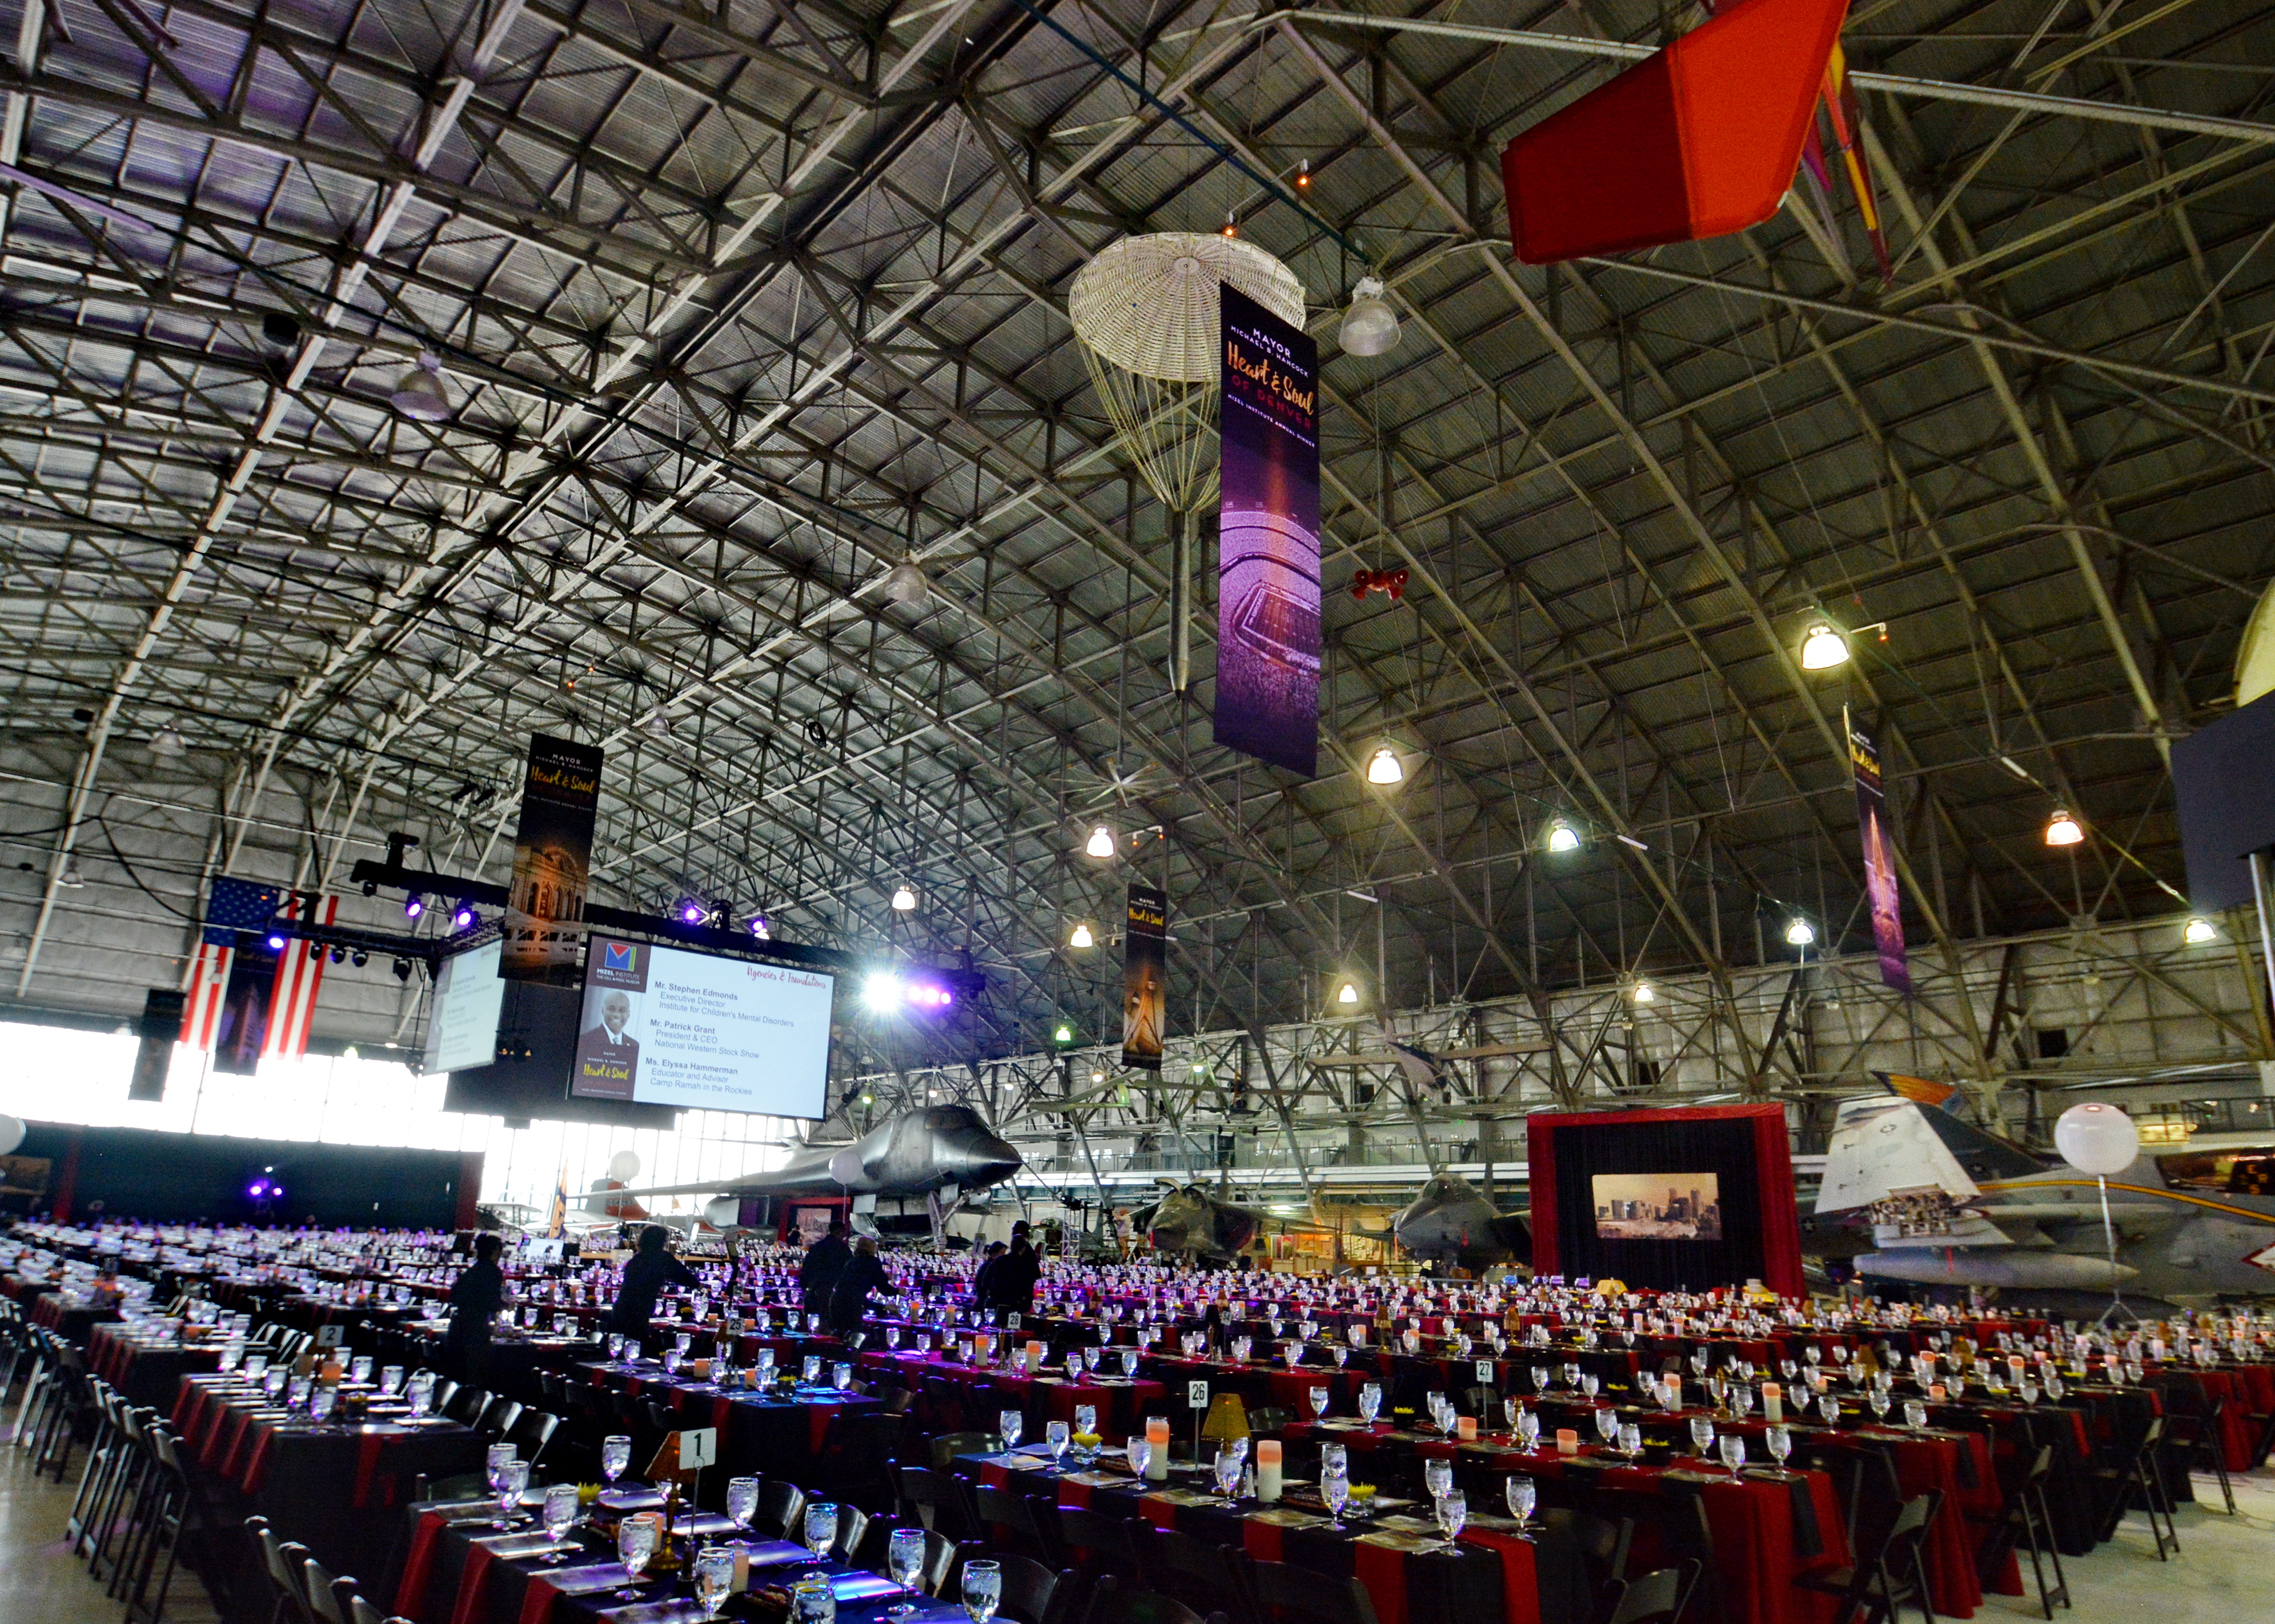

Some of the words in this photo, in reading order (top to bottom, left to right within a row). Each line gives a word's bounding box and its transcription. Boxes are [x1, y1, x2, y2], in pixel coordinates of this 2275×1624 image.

[1231, 325, 1264, 349] MICHAEL
[1267, 347, 1274, 355] B.
[1276, 353, 1309, 377] HANCOCK
[1253, 328, 1290, 358] MAYOR
[1228, 340, 1270, 385] Heart
[1271, 371, 1281, 395] &
[1283, 376, 1314, 415] Soul
[1232, 375, 1249, 390] OF
[1258, 389, 1311, 429] DENVER
[1228, 394, 1244, 406] MIZEL
[1246, 404, 1274, 423] INSTITUTE
[1275, 421, 1295, 436] ANNUAL
[1297, 434, 1315, 448] DINNER
[552, 753, 581, 765] MAYOR
[531, 765, 562, 785] Heart
[571, 775, 596, 794] Soul
[747, 965, 776, 981] Agencies
[655, 981, 666, 989] Mr.
[669, 983, 700, 995] Stephen
[703, 988, 738, 1000] Edmonds
[660, 992, 696, 1003] Executive
[697, 997, 725, 1008] Director
[659, 1001, 688, 1012] Institute
[701, 1007, 736, 1019] Children's
[738, 1012, 761, 1022] Mental
[763, 1016, 794, 1027] Disorders
[650, 1018, 662, 1027] Mr.
[664, 1020, 692, 1031] Patrick
[694, 1025, 715, 1034] Grant
[656, 1029, 691, 1041] President
[700, 1035, 717, 1044] CEO
[655, 1039, 685, 1049] National
[687, 1044, 717, 1054] Western
[719, 1046, 739, 1056] Stock
[740, 1050, 760, 1058] Show
[584, 1063, 605, 1077] Heart
[612, 1067, 629, 1080] Soul
[645, 1057, 659, 1066] Ms.
[662, 1059, 688, 1069] Elyssa
[690, 1062, 738, 1074] Hammerman
[651, 1068, 684, 1078] Educator
[702, 1074, 728, 1082] Advisor
[650, 1077, 673, 1088] Camp
[675, 1080, 701, 1090] Ramah
[725, 1086, 752, 1095] Rockies
[729, 1318, 741, 1330] 25
[1010, 1314, 1019, 1325] 28
[326, 1327, 336, 1341] 2
[1479, 1362, 1490, 1376] 27
[1192, 1383, 1205, 1401] 26
[693, 1432, 701, 1457] 1
